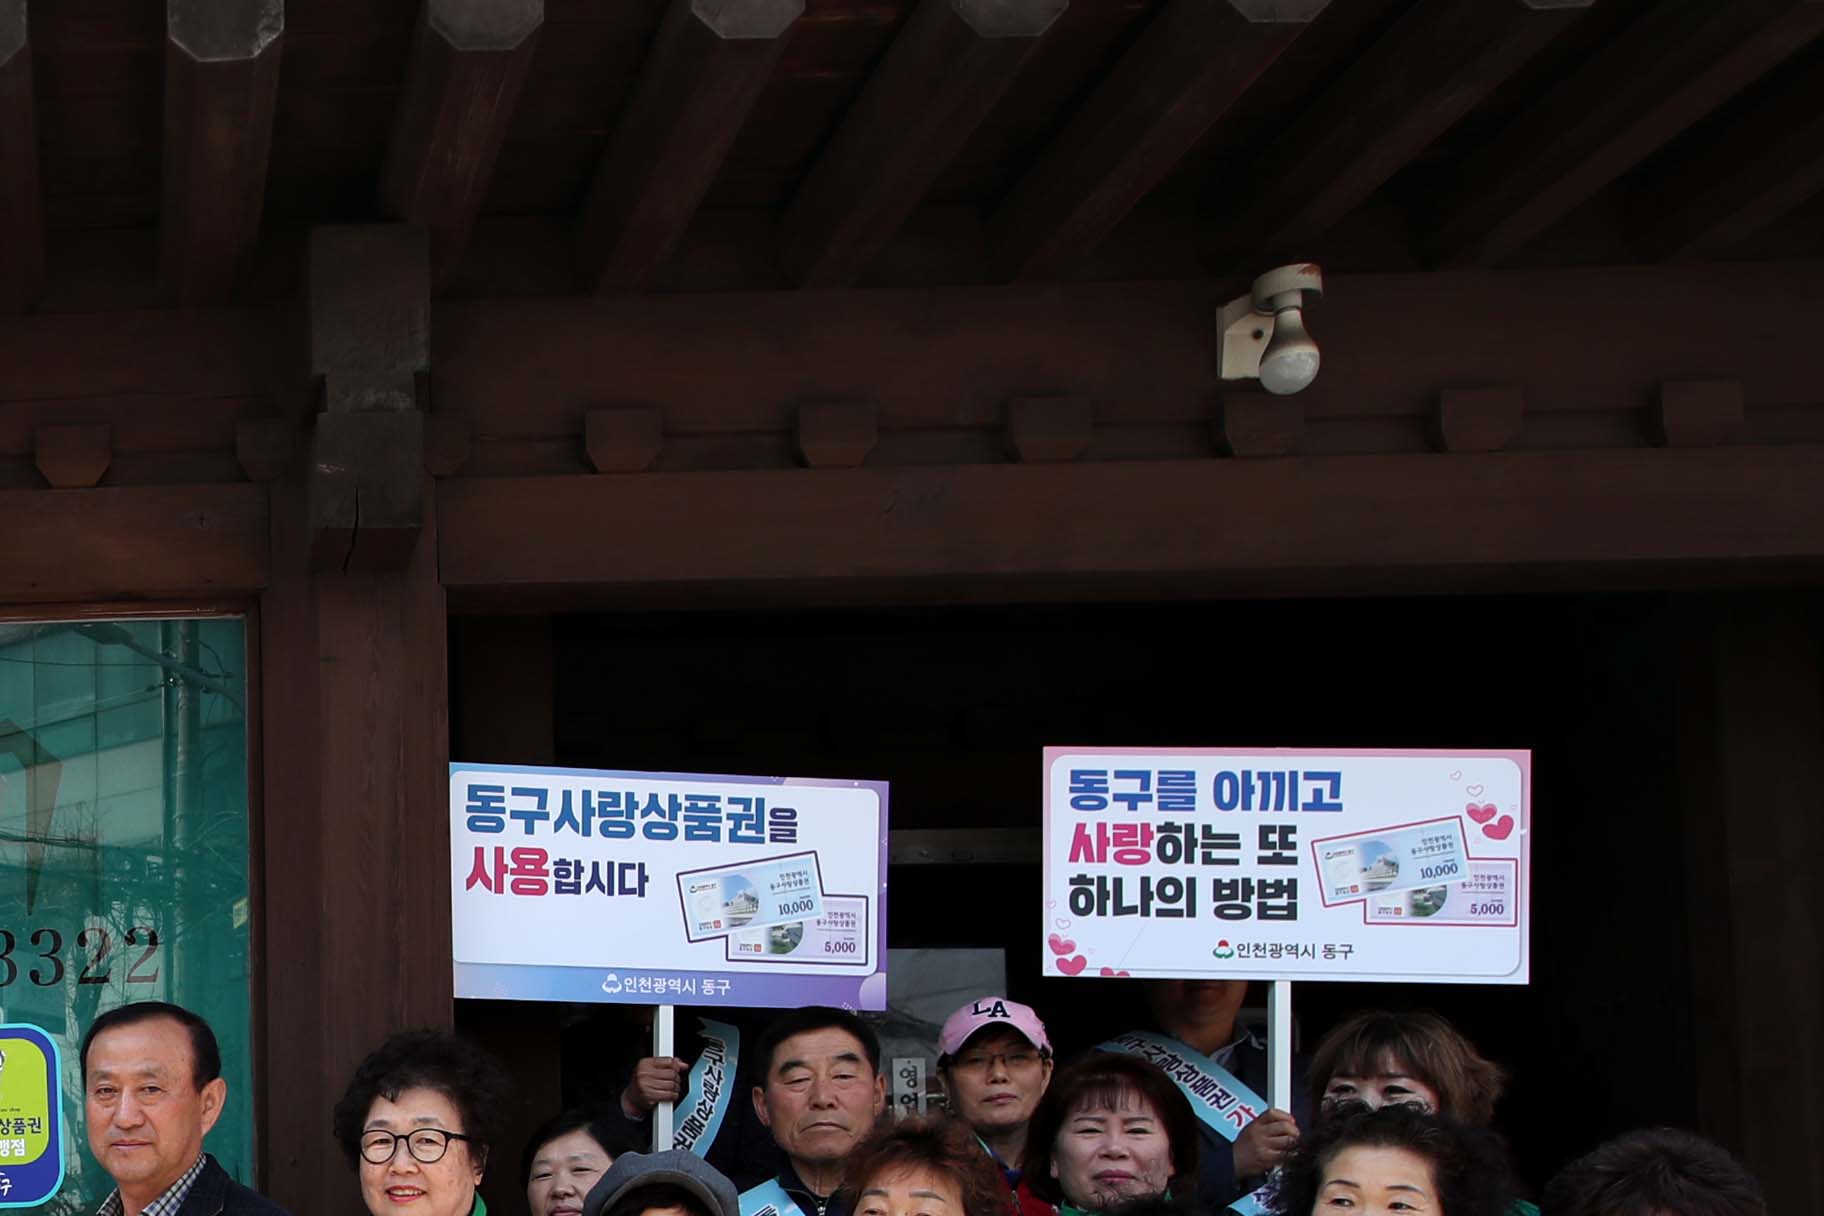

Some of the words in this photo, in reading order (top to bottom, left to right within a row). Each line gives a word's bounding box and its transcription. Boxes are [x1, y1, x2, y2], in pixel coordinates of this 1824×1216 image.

[1068, 769, 1197, 812] 동구를
[1212, 769, 1344, 813] 아끼고
[464, 783, 799, 844] 동구사랑상품권을
[1068, 821, 1241, 867] 사랑하는
[1256, 824, 1299, 867] 또
[464, 846, 650, 898] 사용합시다
[1420, 862, 1459, 880] 10,000
[778, 899, 814, 916] 10,000
[1068, 873, 1197, 919] 하나의
[1212, 876, 1299, 922] 방법
[1470, 903, 1505, 916] 5,000
[824, 941, 857, 953] 5,000
[1236, 942, 1316, 961] 인천광역시
[1321, 944, 1355, 962] 동구
[623, 975, 697, 995] 인천광역시
[701, 979, 731, 997] 동구
[972, 1000, 1011, 1018] LA
